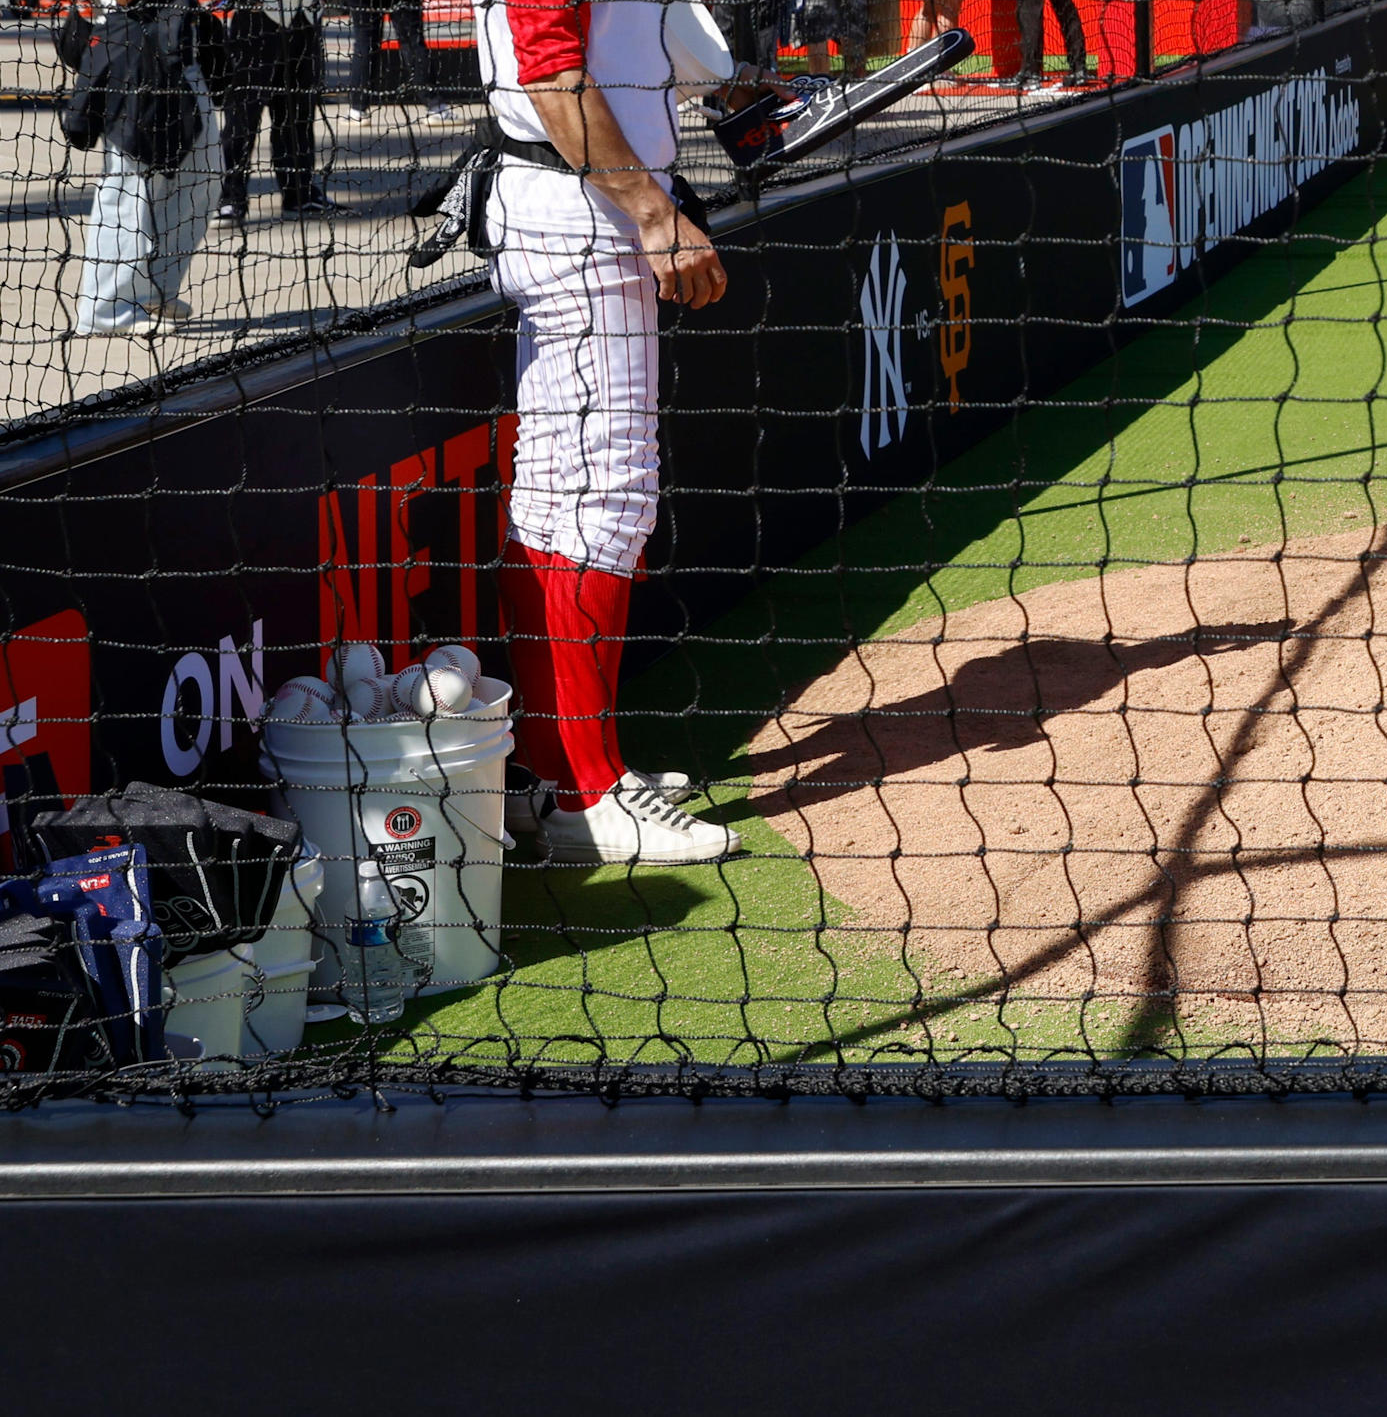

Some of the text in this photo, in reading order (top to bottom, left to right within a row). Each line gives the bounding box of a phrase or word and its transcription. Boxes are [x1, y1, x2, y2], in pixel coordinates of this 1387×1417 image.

[1178, 66, 1360, 270] OPENING NIGHT 2026 Adobe
[160, 617, 265, 778] ON
[384, 838, 431, 853] WARNING
